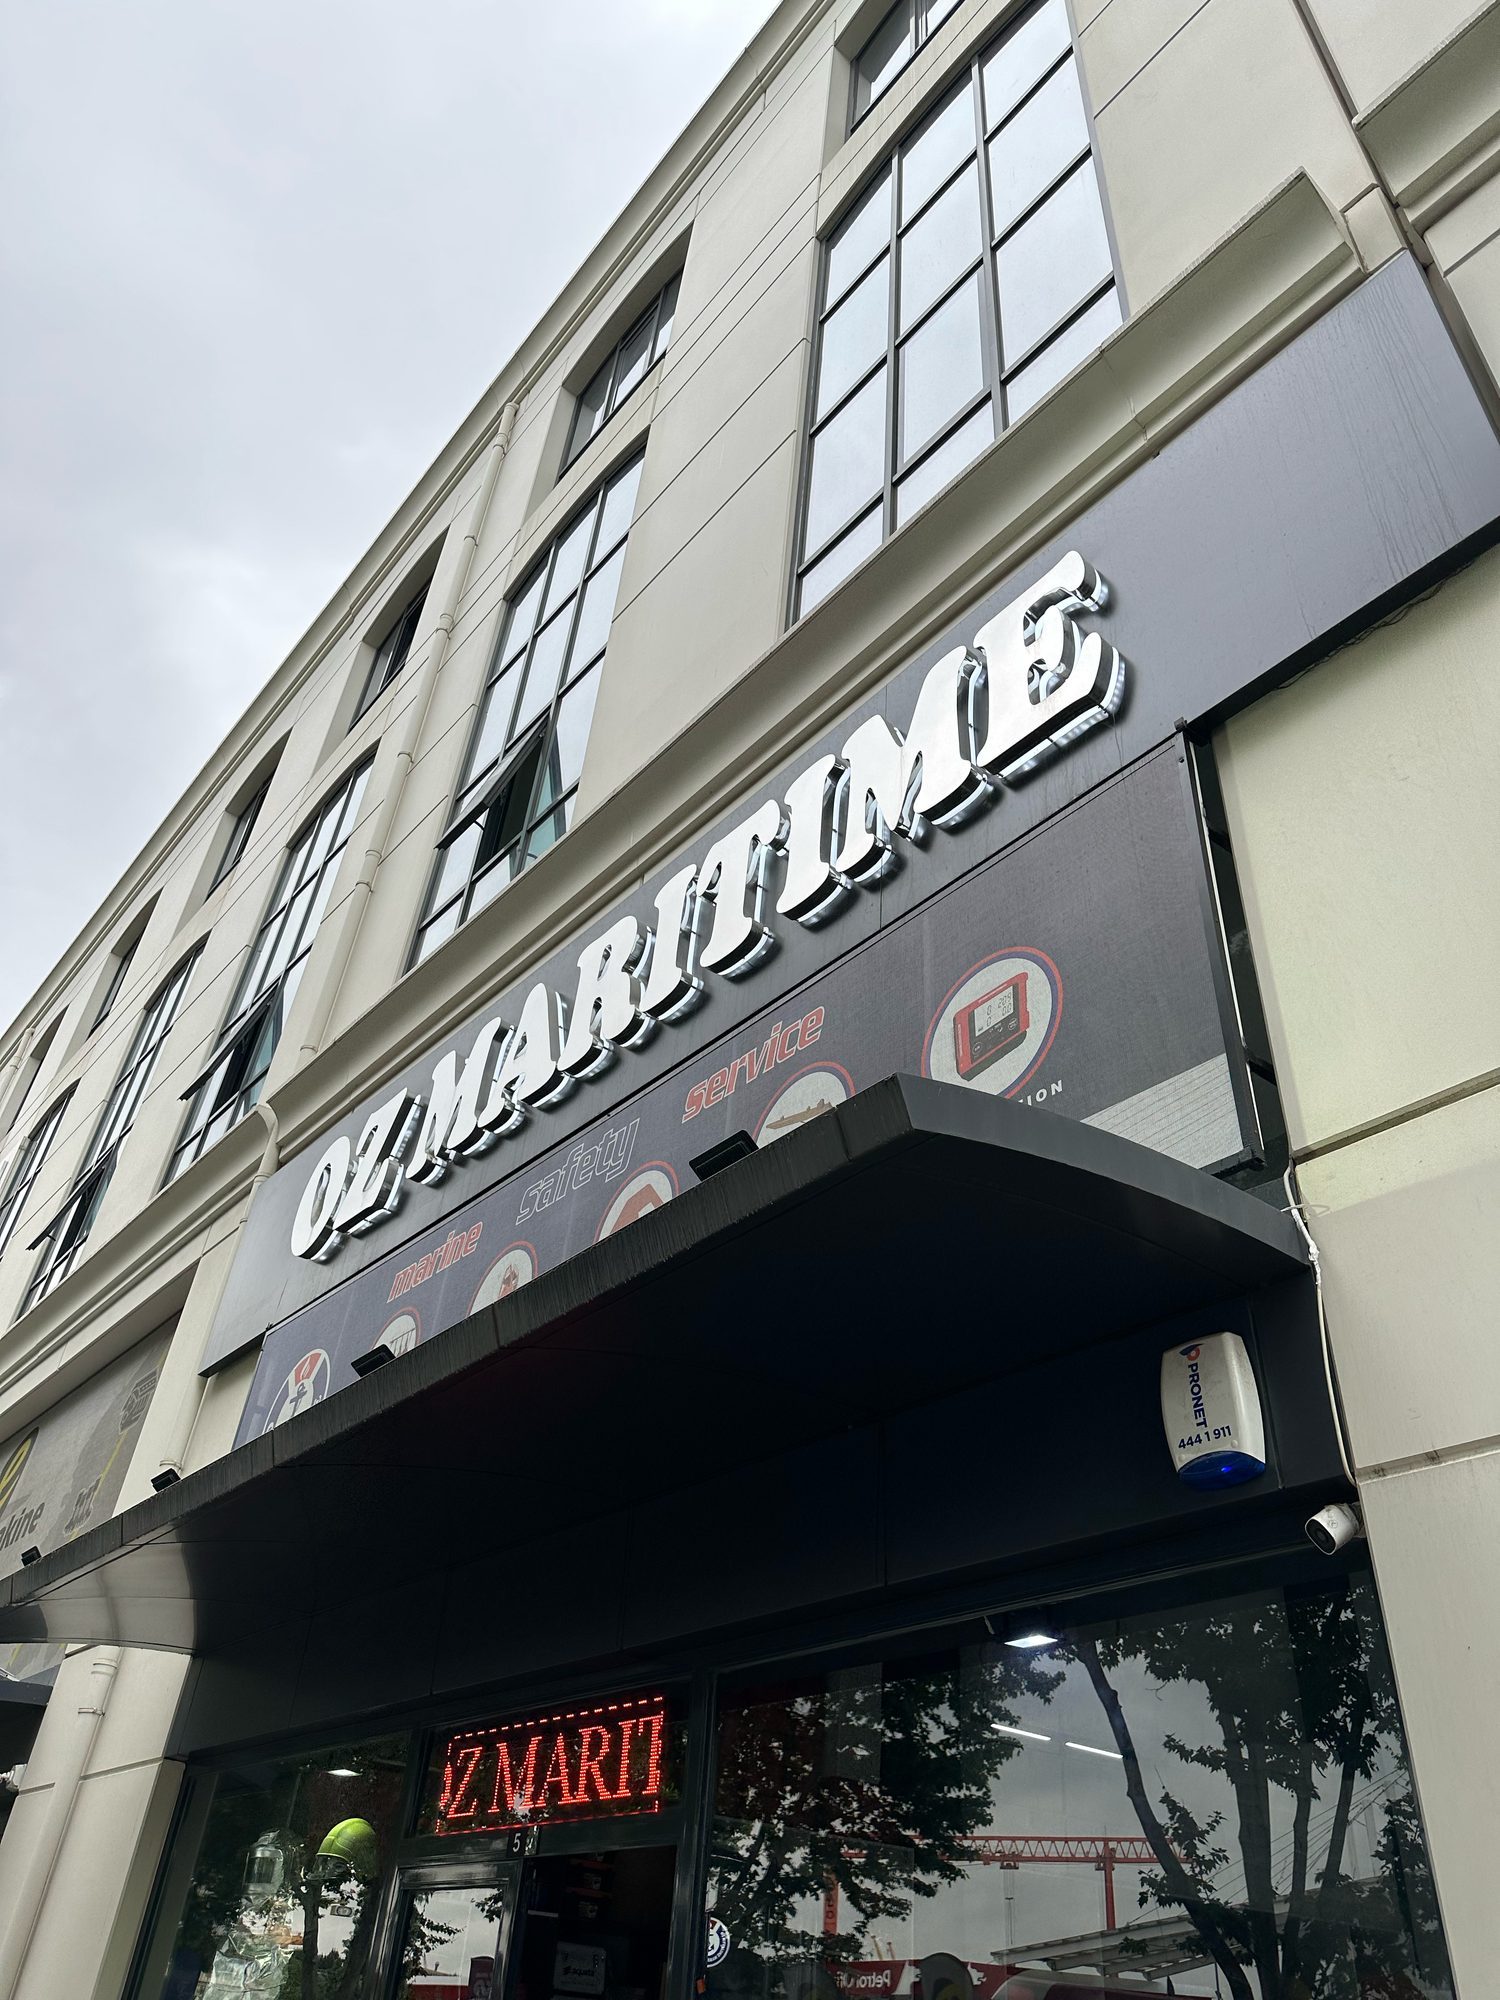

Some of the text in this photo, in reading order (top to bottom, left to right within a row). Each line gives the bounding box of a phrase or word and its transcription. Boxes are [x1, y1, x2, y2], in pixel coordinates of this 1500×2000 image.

[291, 551, 1110, 1258] OZ MARITIME
[1018, 1079, 1063, 1107] ION
[386, 1006, 825, 1303] marine safety service
[1188, 1362, 1208, 1428] PRONET
[1178, 1425, 1232, 1449] 444 1 911
